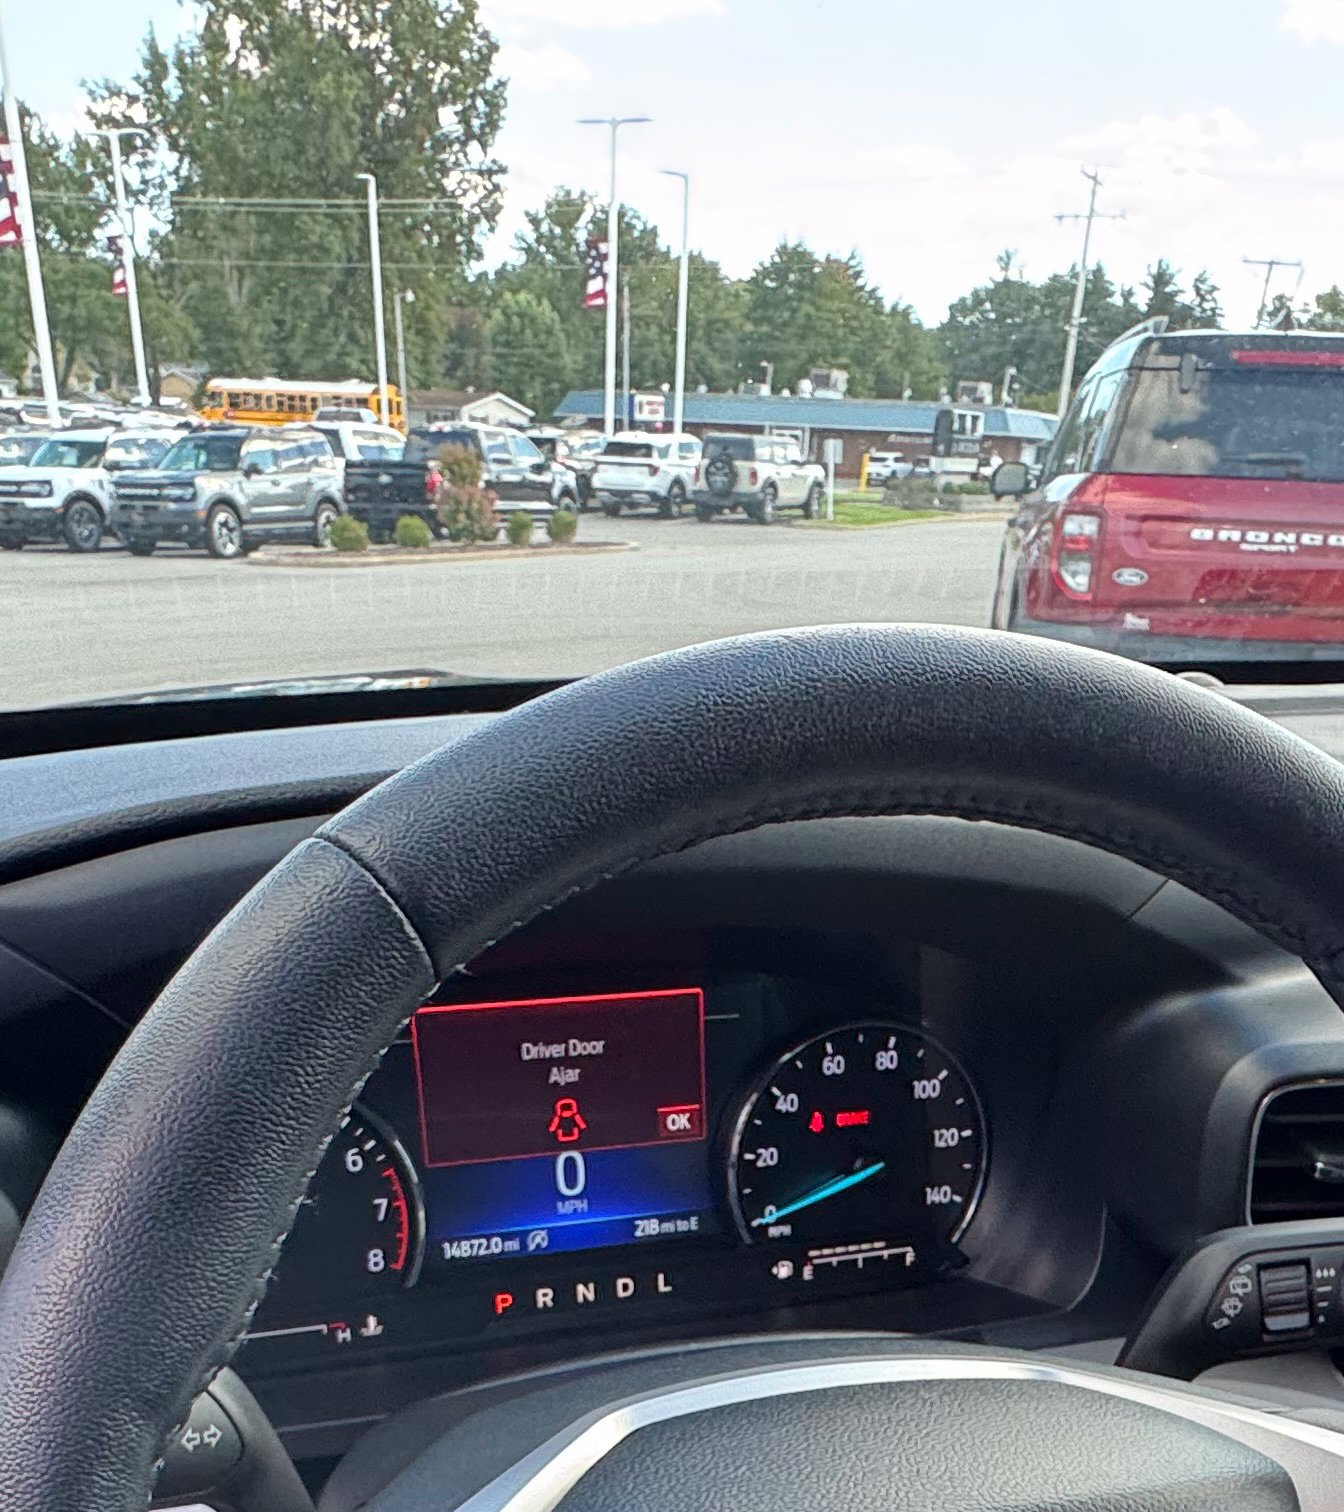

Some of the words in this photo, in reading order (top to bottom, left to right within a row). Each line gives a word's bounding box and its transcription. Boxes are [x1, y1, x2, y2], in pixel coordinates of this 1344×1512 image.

[521, 1040, 566, 1061] Driver
[568, 1038, 605, 1057] Door
[822, 1055, 845, 1076] 60
[875, 1051, 898, 1071] 80
[549, 1067, 581, 1086] Ajar
[912, 1079, 941, 1099] 100
[775, 1093, 799, 1113] 40
[666, 1112, 691, 1131] OK
[933, 1128, 959, 1148] 120
[344, 1147, 364, 1173] 6
[756, 1147, 779, 1168] 20
[555, 1150, 586, 1197] 0
[925, 1185, 952, 1205] 140
[373, 1198, 388, 1222] 7
[557, 1199, 588, 1215] MPH
[763, 1205, 777, 1224] 0
[634, 1217, 659, 1237] 218
[441, 1236, 503, 1260] 14872.0
[367, 1248, 385, 1273] 8
[493, 1292, 513, 1314] P
[536, 1288, 554, 1309] R
[576, 1282, 596, 1303] N
[616, 1277, 635, 1298] D
[657, 1272, 673, 1293] L
[337, 1328, 352, 1344] H
